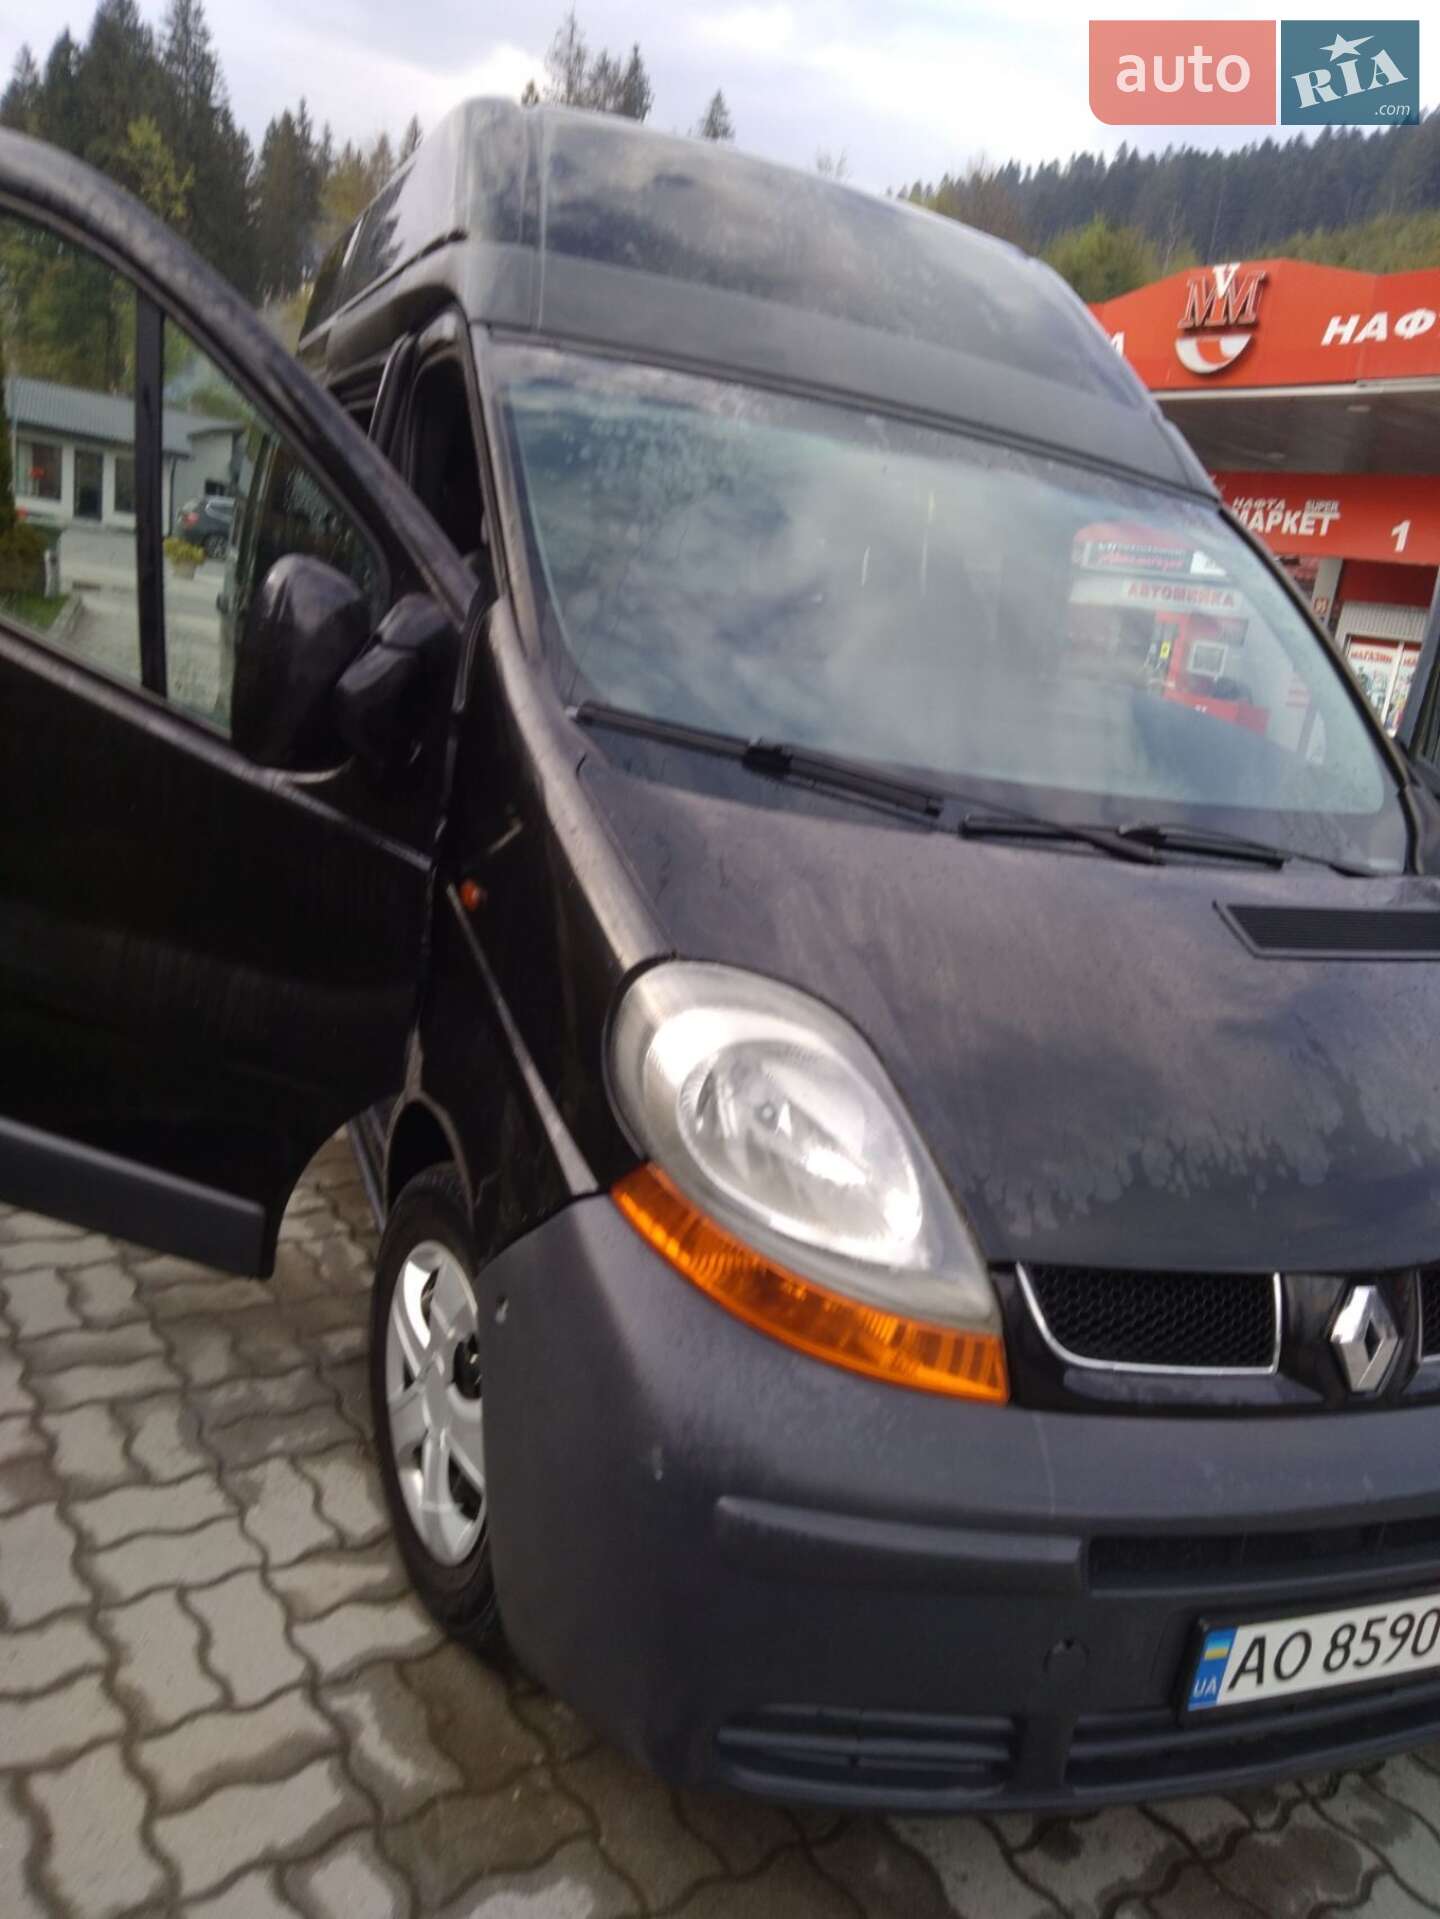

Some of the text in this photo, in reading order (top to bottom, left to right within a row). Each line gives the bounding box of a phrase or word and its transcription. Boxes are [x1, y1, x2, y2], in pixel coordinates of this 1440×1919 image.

[1321, 308, 1440, 346] НАФ
[1391, 519, 1411, 553] 1
[1322, 1606, 1440, 1673] 8590
[1193, 1678, 1218, 1697] UA
